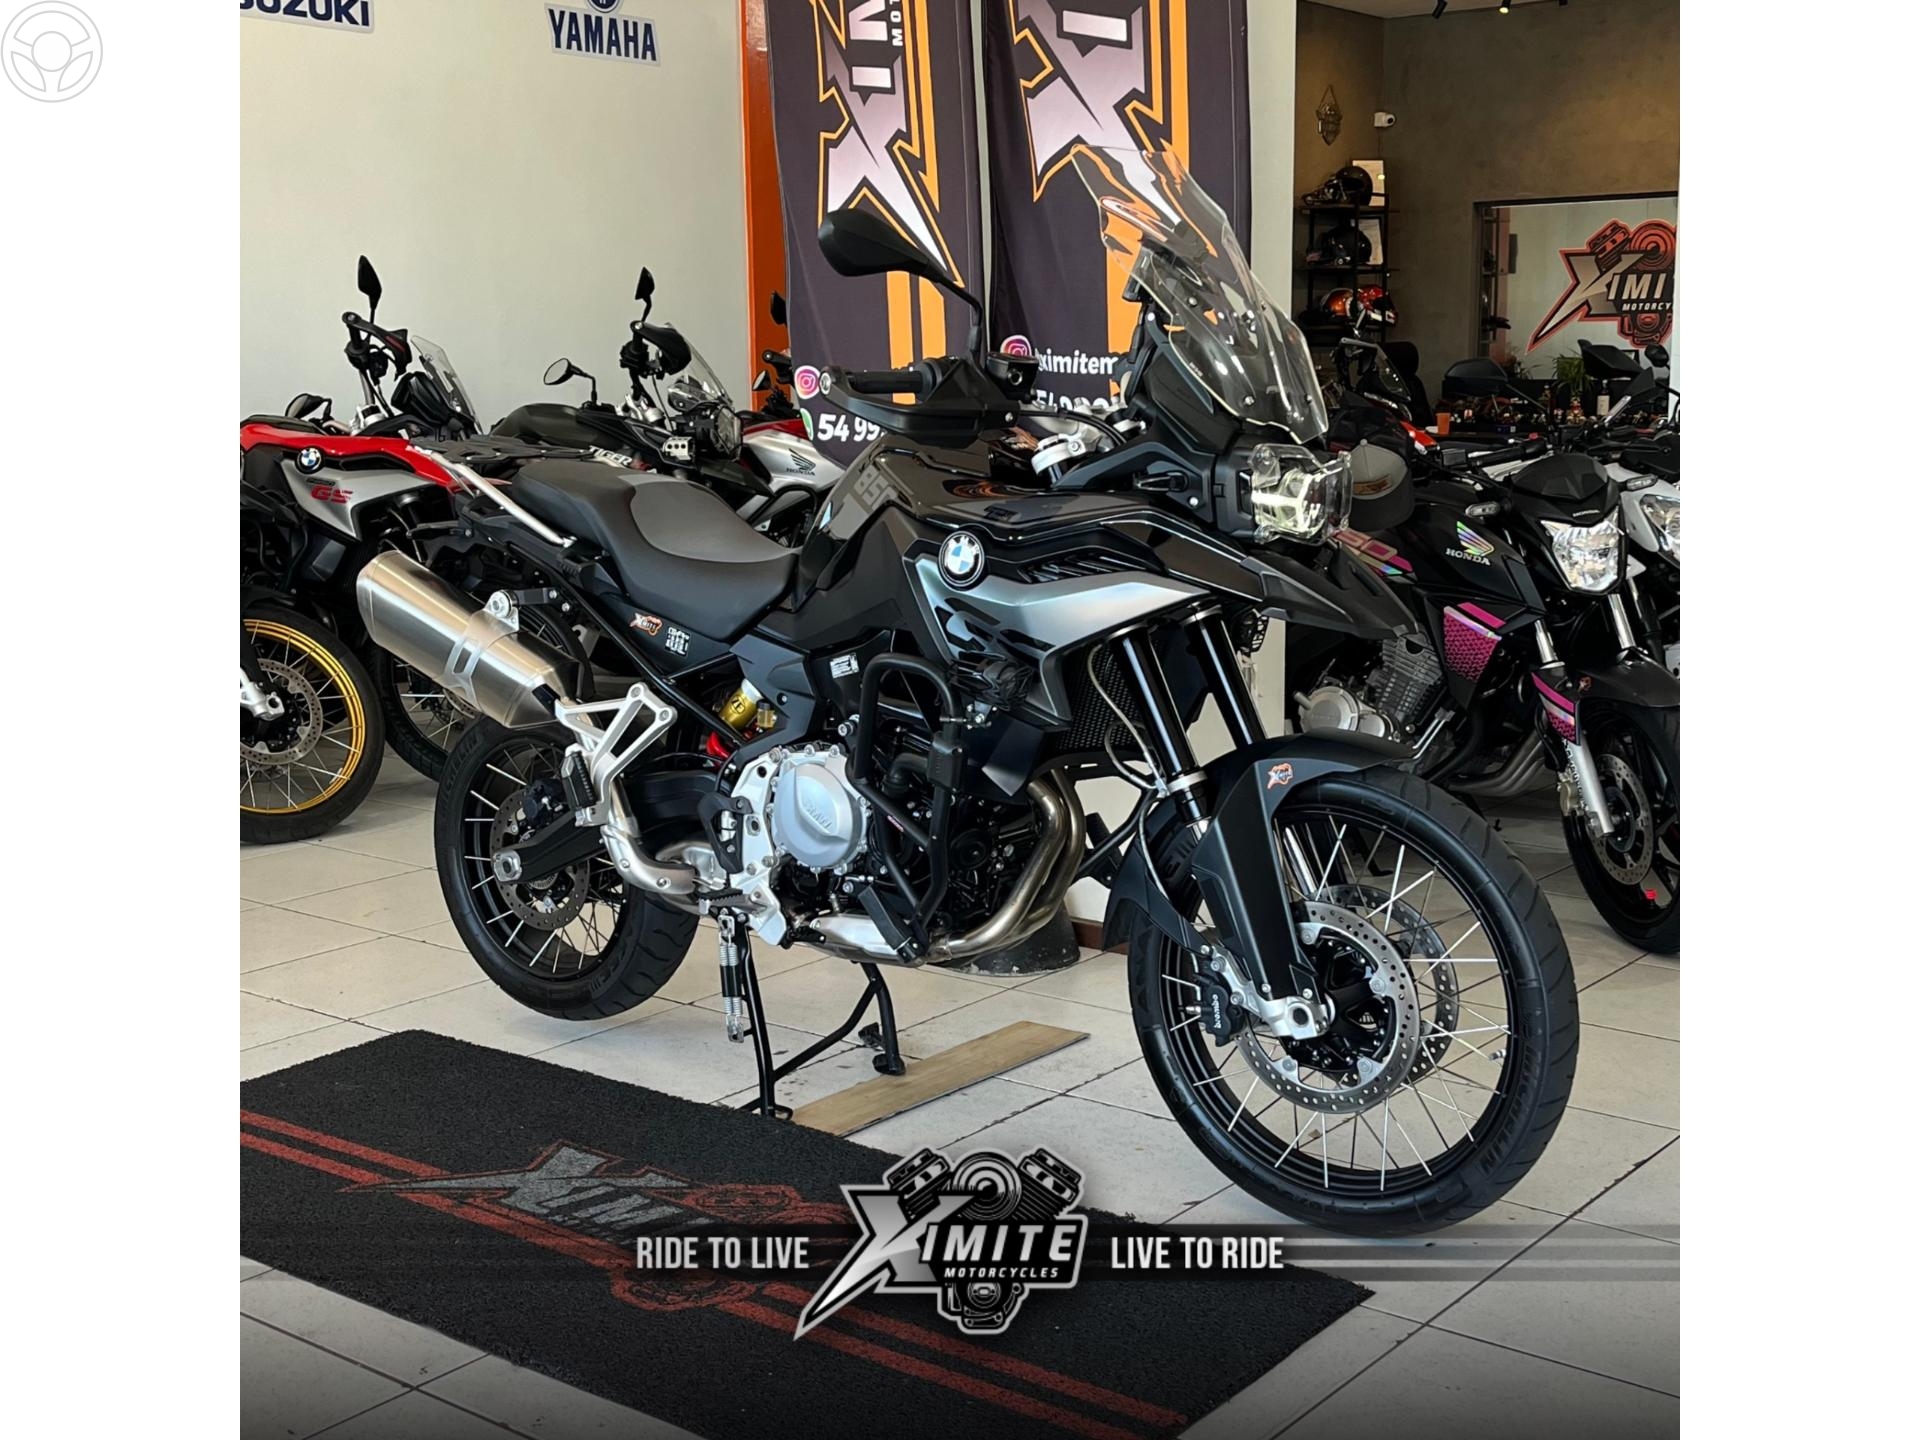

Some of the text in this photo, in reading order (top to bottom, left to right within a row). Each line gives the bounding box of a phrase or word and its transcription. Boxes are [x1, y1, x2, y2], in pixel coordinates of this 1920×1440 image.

[240, 0, 370, 26] UZUKI
[548, 8, 657, 61] YAMAHA
[817, 413, 849, 442] 54
[588, 444, 633, 466] TIGER
[311, 484, 353, 504] GS
[1446, 548, 1491, 566] HONDA
[1211, 993, 1222, 1028] brembo
